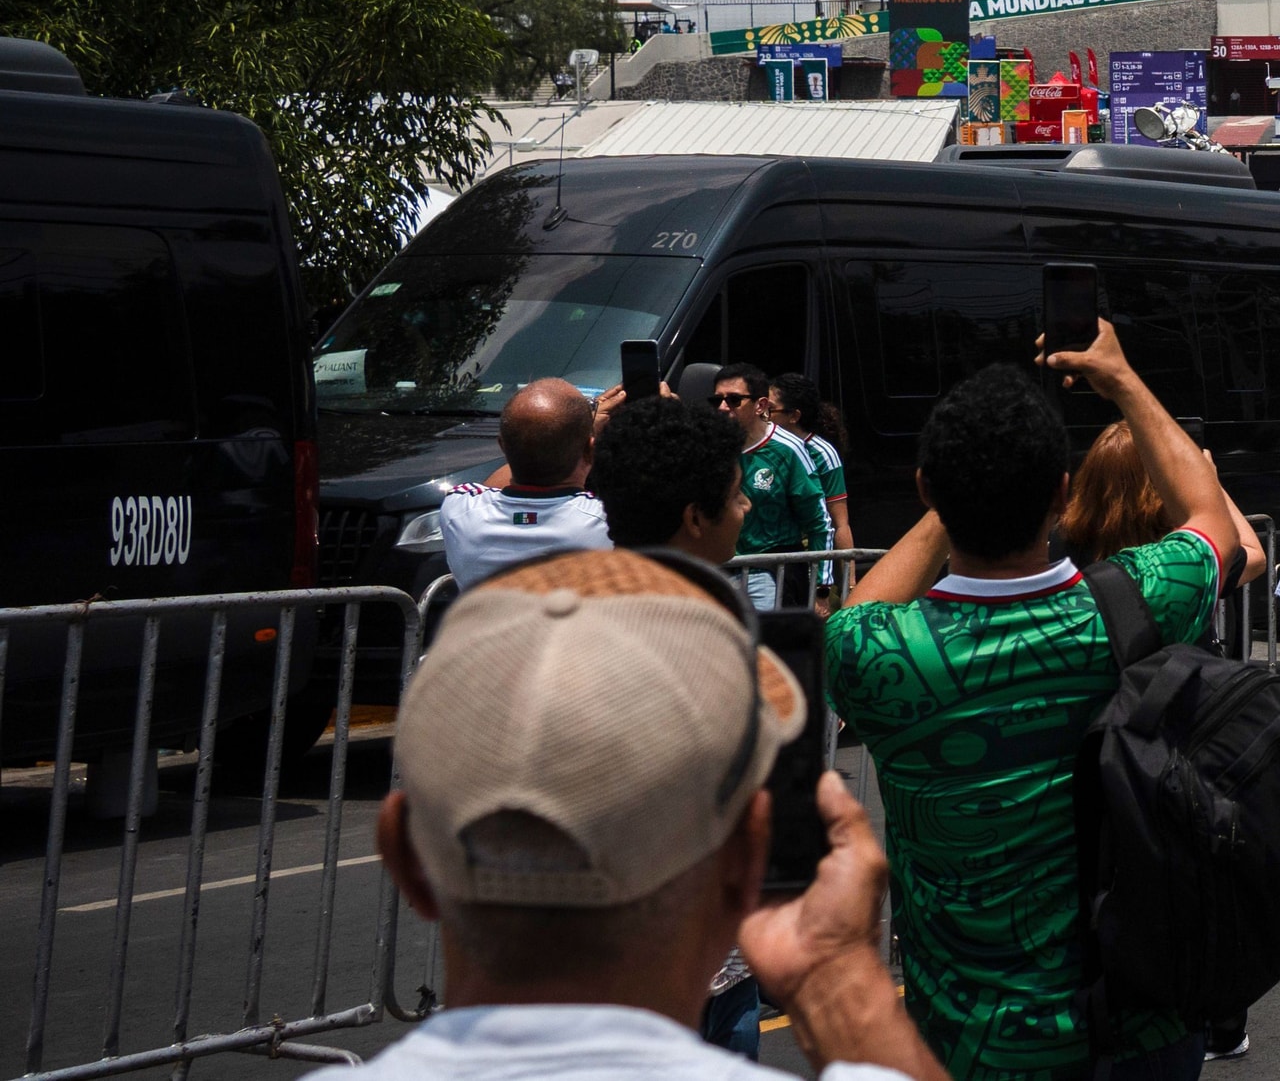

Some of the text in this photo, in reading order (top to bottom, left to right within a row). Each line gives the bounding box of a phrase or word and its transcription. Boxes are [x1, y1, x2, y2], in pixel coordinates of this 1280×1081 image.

[1212, 45, 1227, 58] 30
[652, 231, 697, 249] 270
[110, 495, 192, 567] 93RD8U
